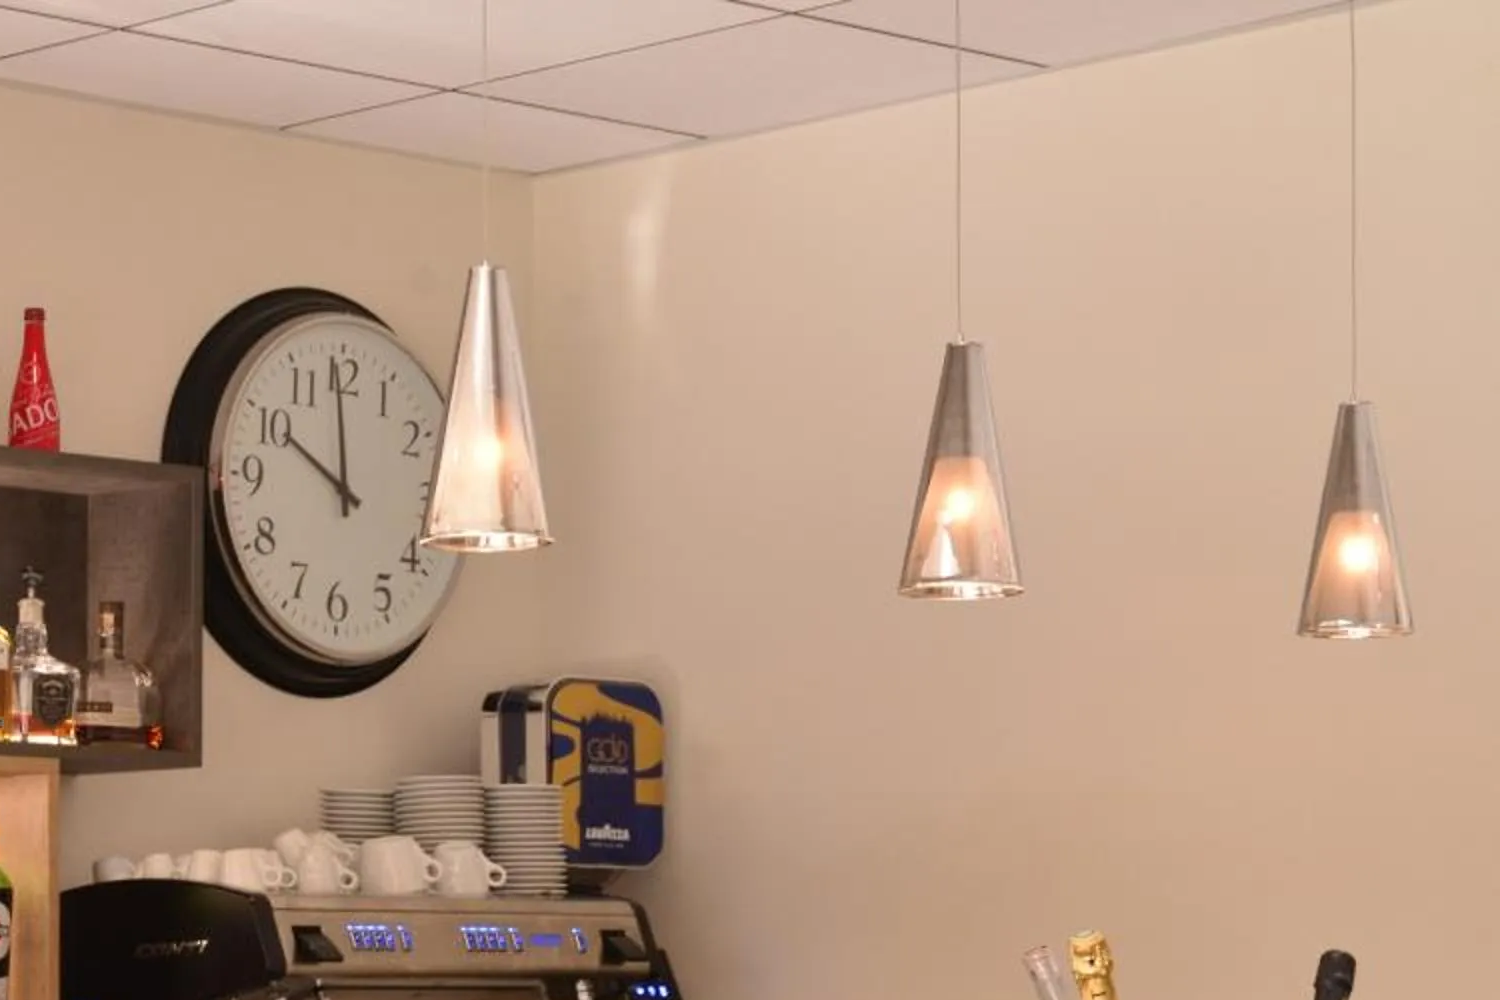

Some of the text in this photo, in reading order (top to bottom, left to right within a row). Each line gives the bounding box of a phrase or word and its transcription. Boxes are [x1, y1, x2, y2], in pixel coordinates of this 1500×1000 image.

[291, 367, 316, 408] 11
[328, 355, 359, 397] 12
[378, 380, 389, 418] 1
[259, 407, 291, 448] 10
[401, 420, 420, 458] 2
[242, 455, 264, 496] 9
[254, 516, 276, 555] 8
[399, 533, 421, 573] 4
[291, 561, 309, 600] 7
[373, 573, 392, 613] 5
[326, 581, 348, 622] 6
